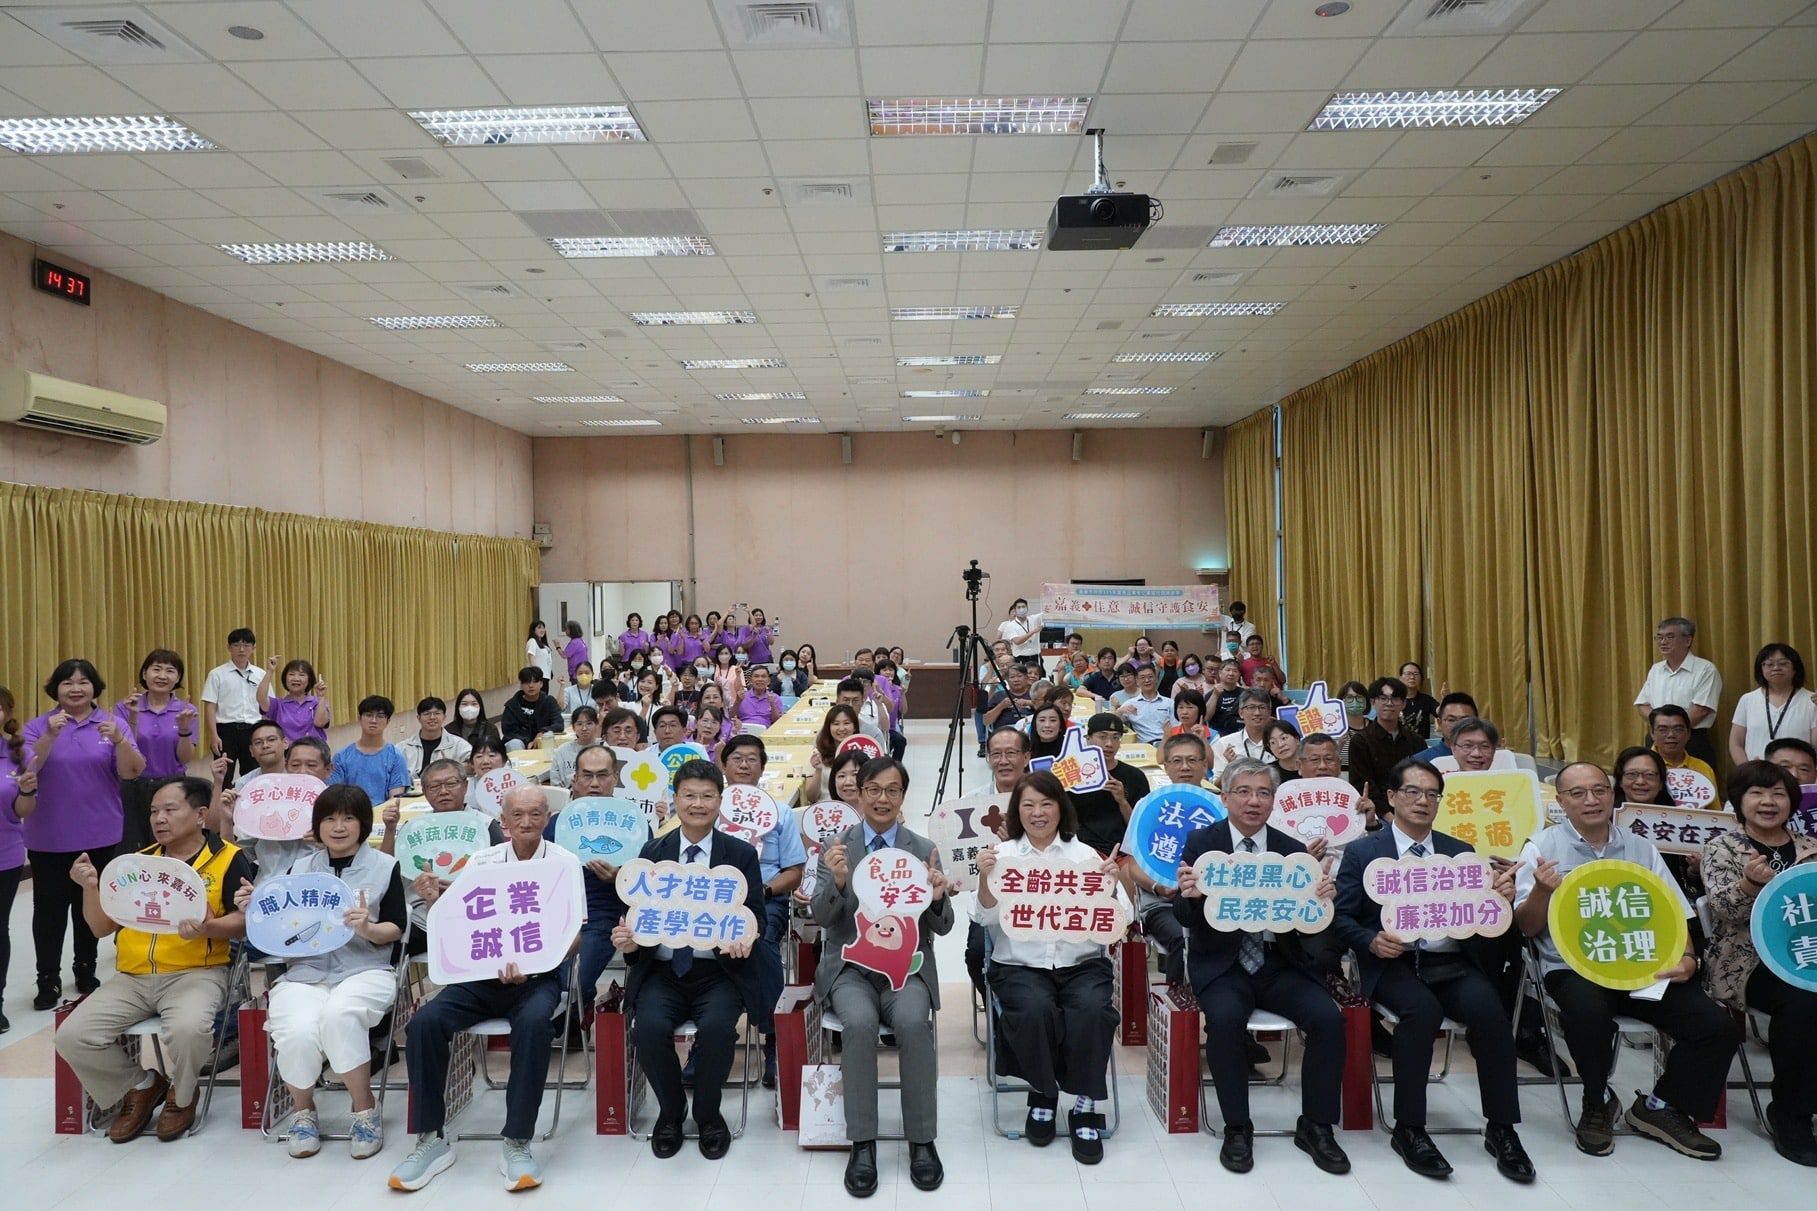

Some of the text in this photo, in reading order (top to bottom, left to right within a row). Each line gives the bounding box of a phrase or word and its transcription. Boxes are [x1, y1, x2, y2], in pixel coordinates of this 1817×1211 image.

[249, 785, 319, 807] 安心鮮肉
[483, 773, 517, 793] 食品
[1671, 787, 1711, 800] 誠信
[731, 787, 761, 810] 食安
[1279, 789, 1351, 815] 誠信料理
[1447, 789, 1507, 816] 法令
[567, 811, 638, 833] 尚青魚貨
[732, 808, 773, 829] 誠信
[1158, 799, 1217, 830] 法令
[406, 825, 478, 850] 鮮蔬保證
[868, 857, 913, 883] 食品
[1000, 868, 1106, 897] 全齡共享
[1203, 862, 1312, 890] 杜絕黑心
[1375, 864, 1484, 896] 誠信治理
[463, 881, 541, 921] 企業
[627, 870, 738, 904] 人才培育
[880, 884, 927, 908] 安全
[258, 888, 342, 917] 職人精神
[1394, 899, 1503, 931] 廉潔加分
[1577, 885, 1651, 920] 誠信
[634, 908, 746, 941] 產學合作
[1010, 903, 1115, 932] 世代宜居
[470, 921, 543, 961] 誠信
[1583, 929, 1660, 962] 治理
